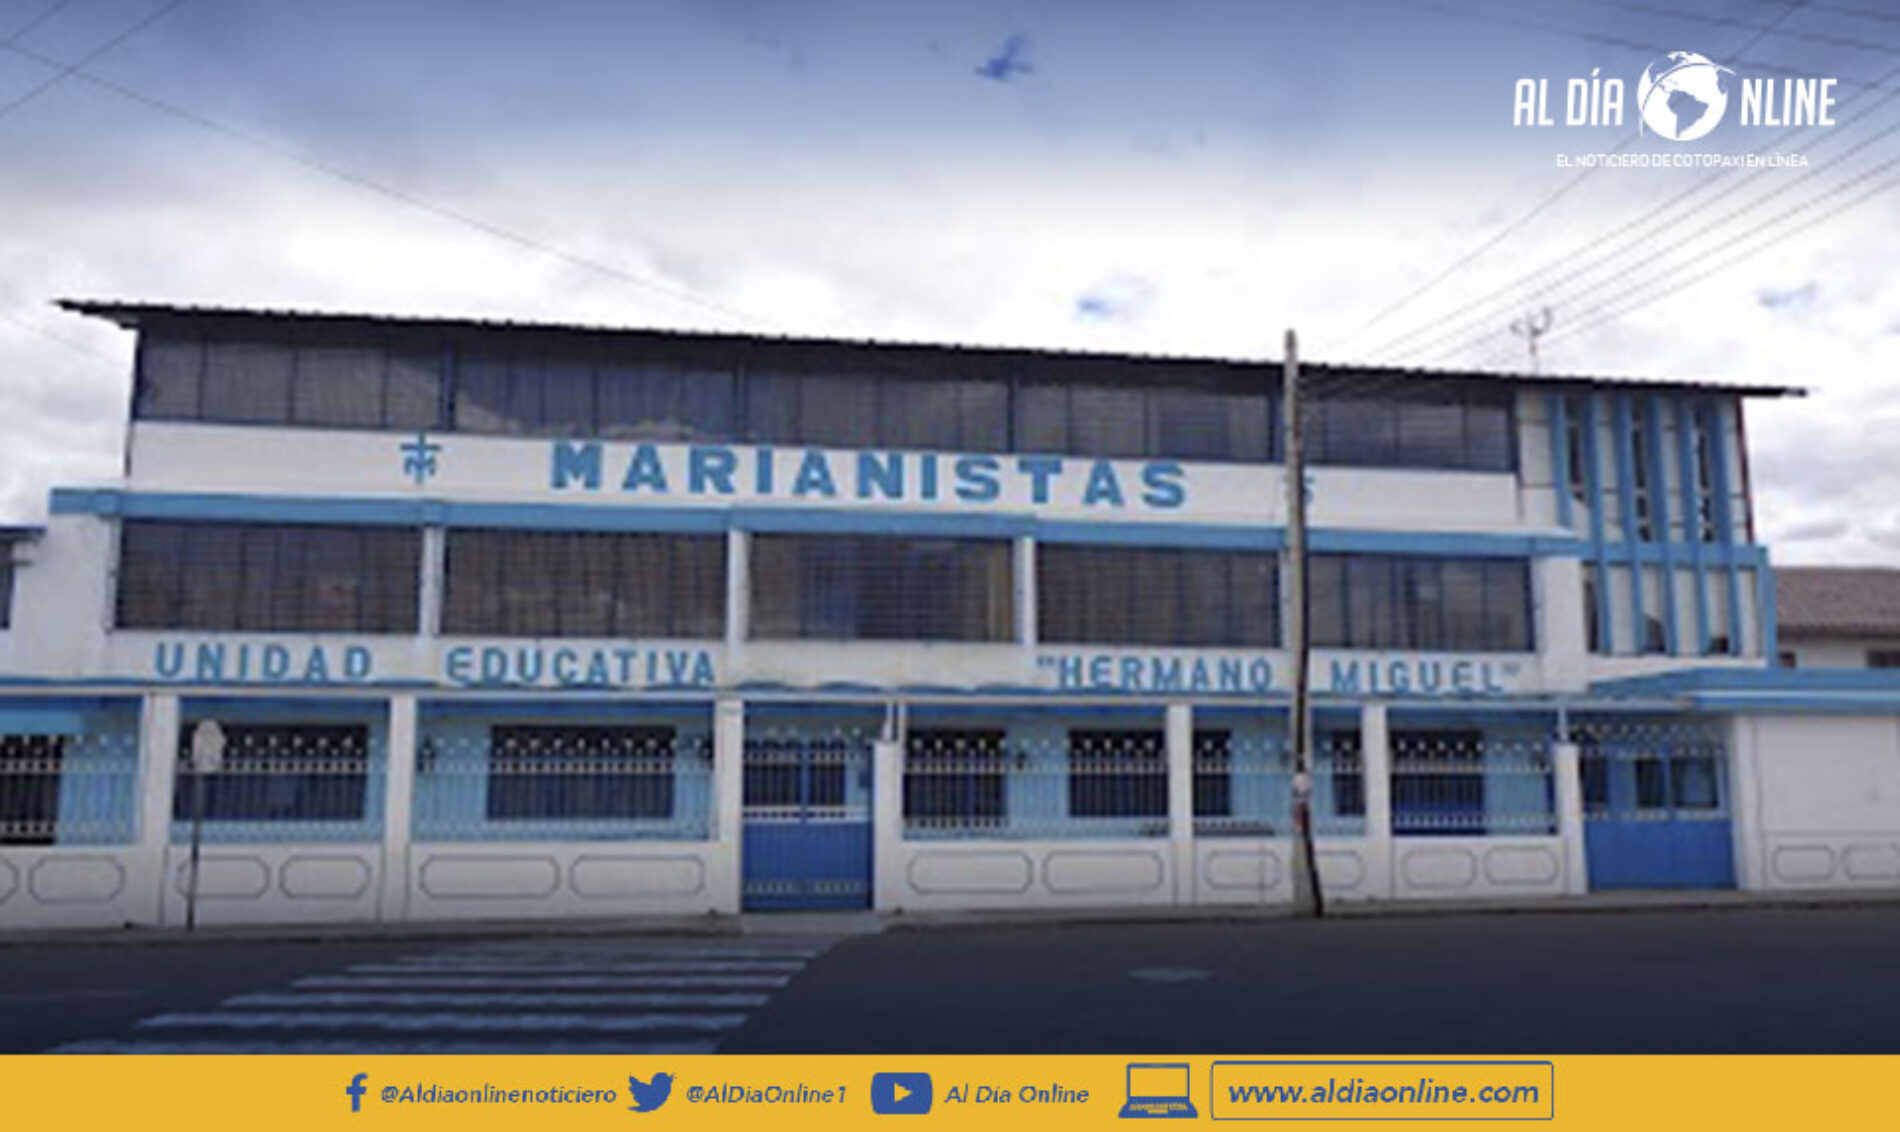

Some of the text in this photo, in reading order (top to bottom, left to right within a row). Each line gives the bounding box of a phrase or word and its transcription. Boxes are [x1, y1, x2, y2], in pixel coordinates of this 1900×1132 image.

[550, 439, 1188, 508] MARIANISTAS
[154, 641, 373, 682] UNIDAD
[444, 646, 716, 687] EDUCATIVA
